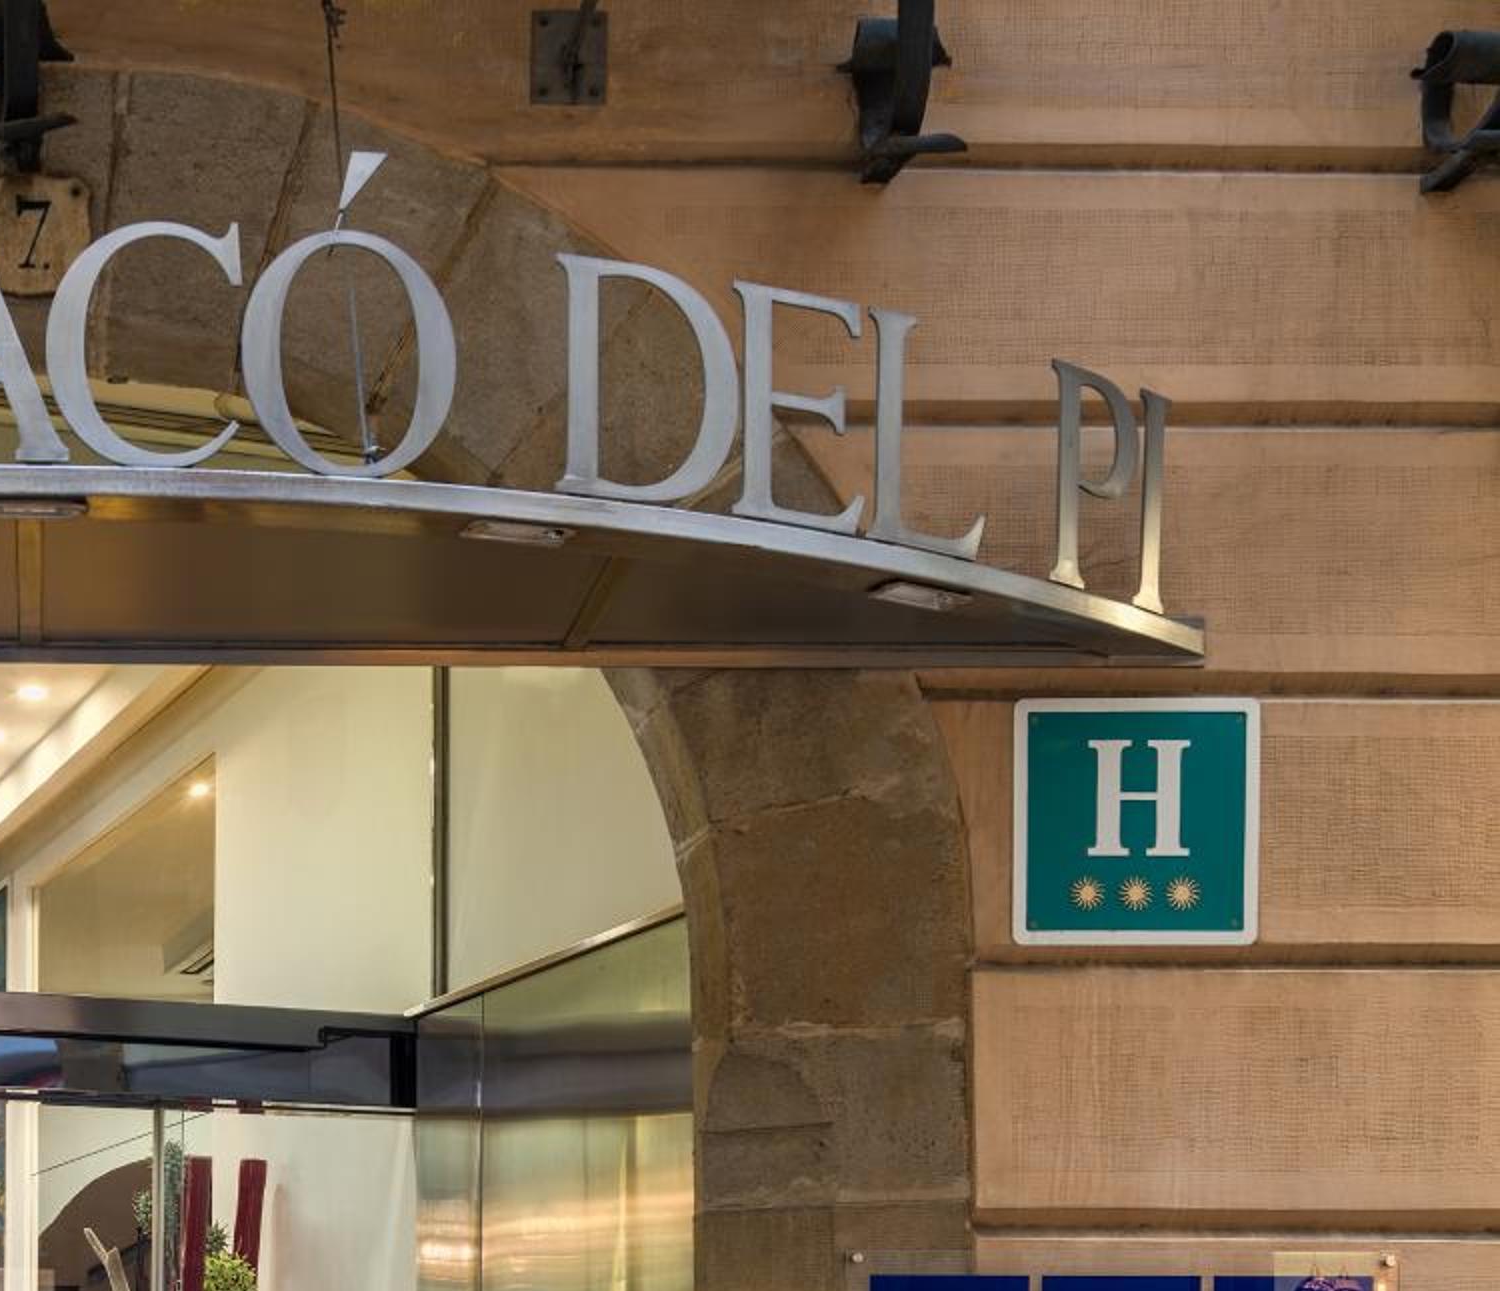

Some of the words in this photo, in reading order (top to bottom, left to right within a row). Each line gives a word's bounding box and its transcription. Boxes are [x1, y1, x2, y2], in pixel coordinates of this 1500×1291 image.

[555, 252, 986, 561] DEL
[1049, 358, 1172, 615] PI
[1087, 739, 1191, 858] H
